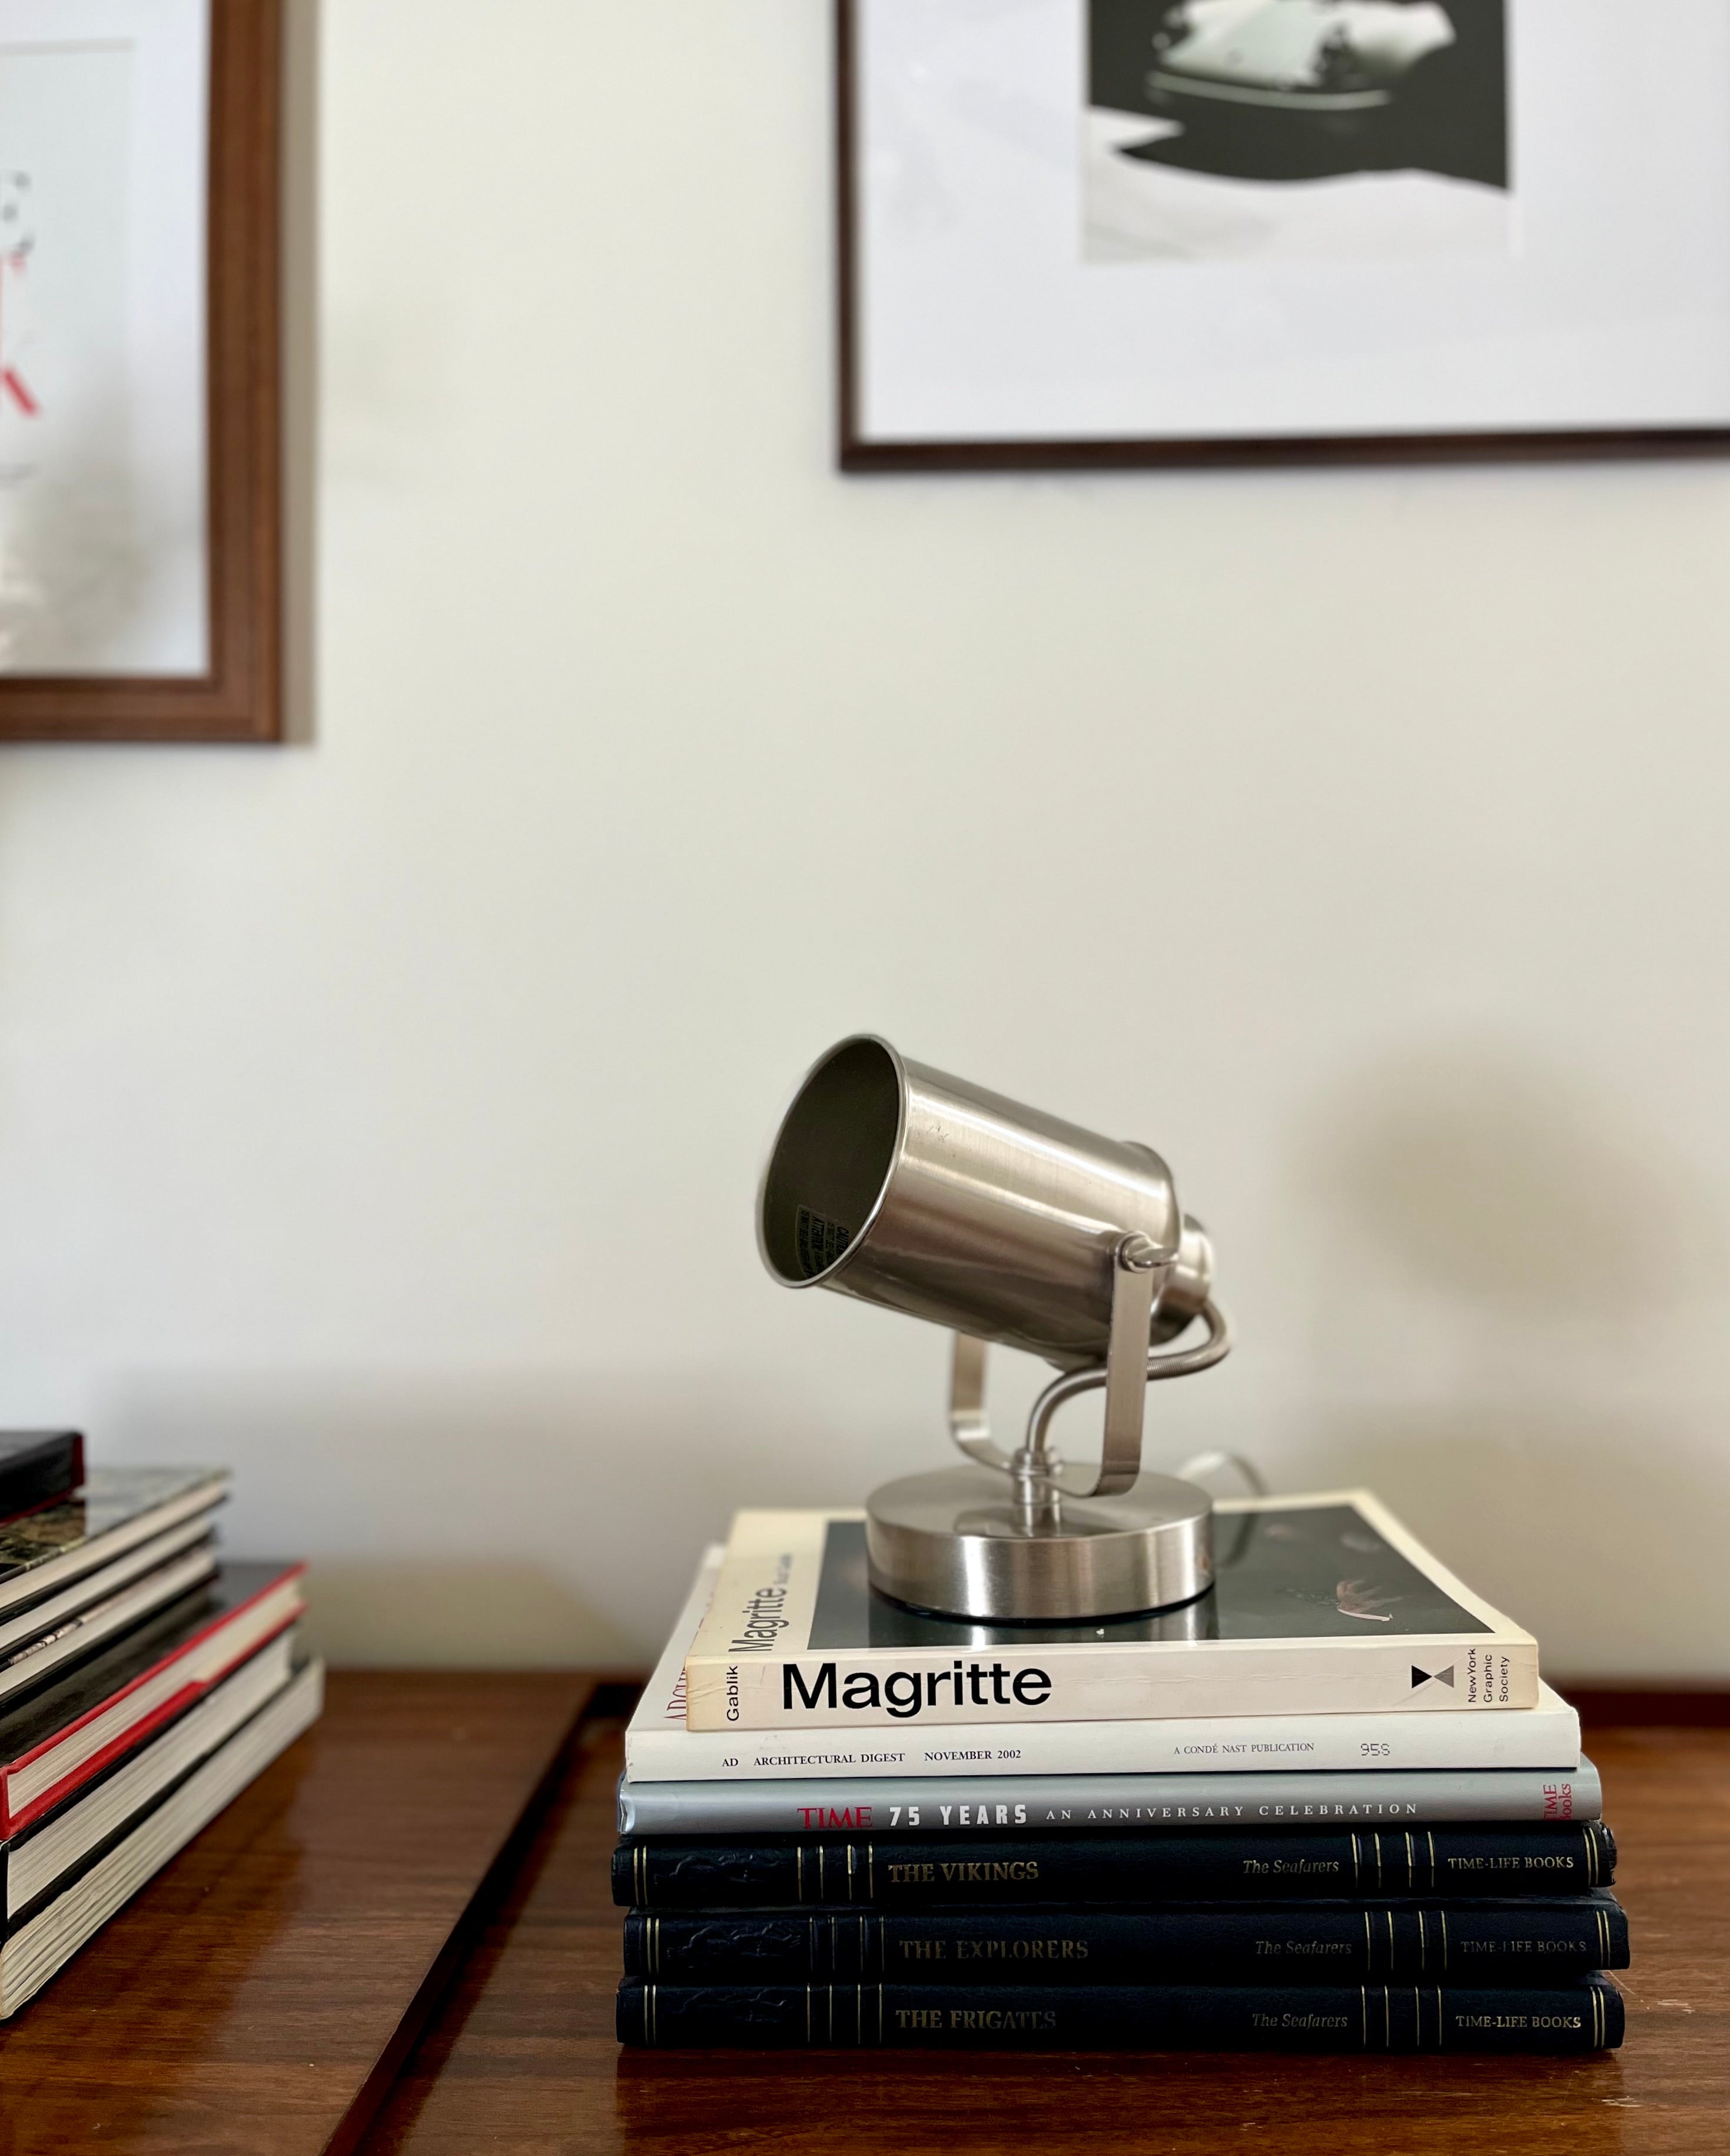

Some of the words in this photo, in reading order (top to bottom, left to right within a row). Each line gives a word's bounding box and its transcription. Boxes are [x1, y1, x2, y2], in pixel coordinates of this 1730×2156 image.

[728, 1587, 789, 1652] Magritte
[1483, 1655, 1494, 1702] Graphic
[1499, 1656, 1510, 1702] Society
[726, 1666, 739, 1721] Gablik
[783, 1660, 1052, 1718] Magritte
[1184, 1744, 1218, 1753] CONDÉ
[1222, 1745, 1247, 1753] NAST
[1251, 1743, 1314, 1752] PUBLICATION
[722, 1758, 739, 1766] AD
[753, 1755, 856, 1766] ARCHITECTURAL
[861, 1753, 905, 1762] DIGEST
[924, 1750, 992, 1761] NOVEMBER
[997, 1750, 1021, 1759] 2002
[797, 1806, 873, 1829] TIME
[889, 1806, 920, 1826] 75
[939, 1804, 1027, 1825] YEARS
[1046, 1810, 1071, 1819] AN
[1087, 1806, 1243, 1819] ANNIVERSARY
[1259, 1804, 1417, 1816] CELEBRATION
[888, 1863, 935, 1882] THE
[940, 1861, 1039, 1882] VIKINGS
[1243, 1860, 1269, 1873] The
[1273, 1859, 1339, 1874] Seafarers
[1448, 1858, 1520, 1869] TIME-LIFE
[1525, 1856, 1574, 1868] BOOKS
[899, 1940, 947, 1959] THE
[957, 1939, 1089, 1959] EXPLORERS
[1256, 1941, 1281, 1954] The
[1286, 1941, 1352, 1955] Seafarers
[1461, 1941, 1532, 1952] TIME-LIFE
[1538, 1941, 1587, 1953] BOOKS
[895, 2010, 942, 2029] THE
[949, 2010, 1056, 2029] FRIGATES
[1253, 2014, 1278, 2027] The
[1282, 2014, 1348, 2029] Seafarers
[1456, 2016, 1527, 2028] TIME-LIFE
[1532, 2016, 1581, 2028] BOOKS
